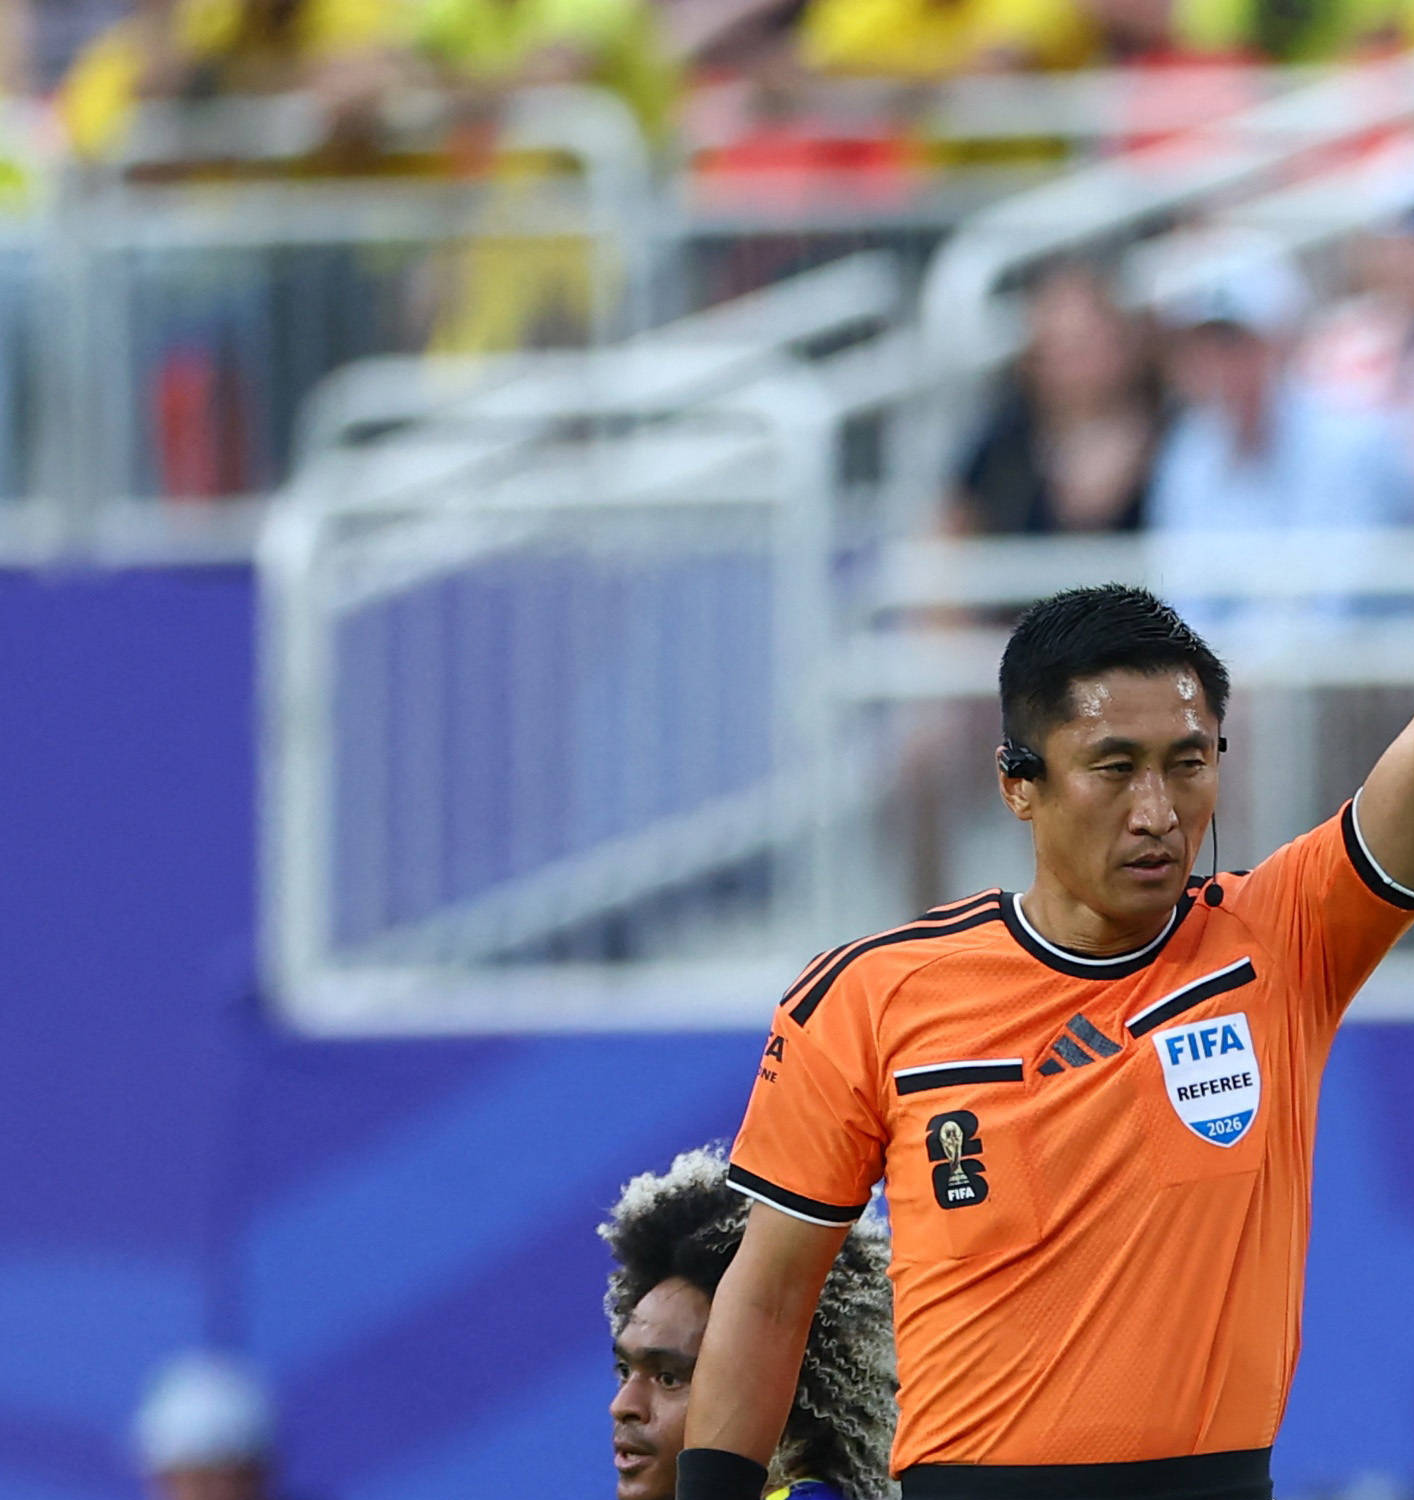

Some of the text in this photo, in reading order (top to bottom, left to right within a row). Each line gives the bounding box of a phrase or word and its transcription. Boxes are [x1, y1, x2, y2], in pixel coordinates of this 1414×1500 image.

[1165, 1024, 1245, 1066] FIFA
[1177, 1072, 1253, 1101] REFEREE
[1207, 1117, 1243, 1137] 2026
[947, 1186, 975, 1202] FIFA
